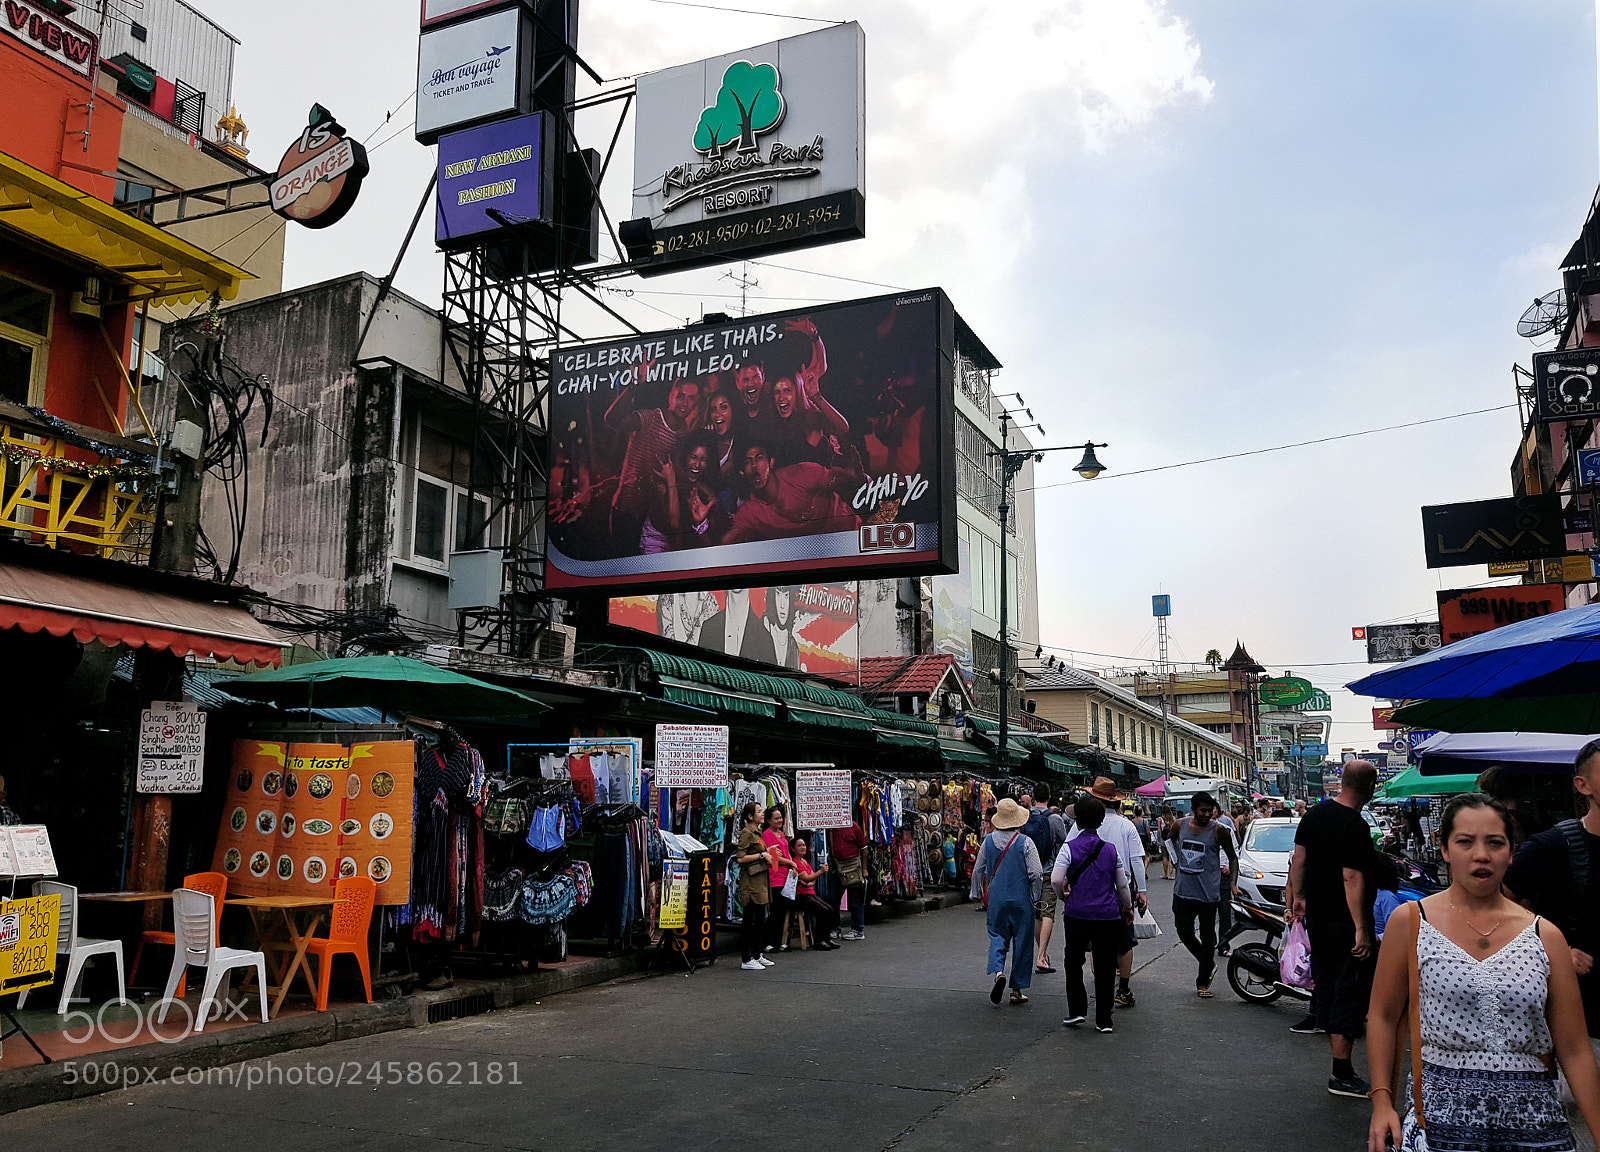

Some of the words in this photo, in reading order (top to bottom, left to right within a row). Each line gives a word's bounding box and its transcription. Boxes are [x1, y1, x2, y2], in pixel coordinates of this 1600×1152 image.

[5, 0, 90, 64] VIEW
[431, 68, 455, 86] Bon
[459, 58, 501, 80] voyage
[433, 87, 455, 99] TICKET
[455, 83, 470, 93] AND
[471, 77, 495, 89] TRAVEL
[299, 121, 332, 153] IS
[275, 147, 349, 200] ORANGE
[445, 159, 477, 179] NEW
[477, 145, 532, 172] ARMANI
[662, 151, 762, 197] Khaosan
[768, 134, 824, 165] Park
[458, 179, 516, 205] FASHION
[703, 185, 773, 213] RESORT
[673, 333, 715, 356] LIKE
[720, 323, 785, 347] THAIS.
[557, 366, 639, 396] CHAI-YO!
[646, 360, 690, 384] WITH
[862, 524, 913, 550] LEO
[142, 711, 169, 725] Chang
[175, 711, 206, 724] 80/100
[165, 702, 184, 711] Beer
[141, 734, 166, 746] Singha
[142, 724, 161, 733] Leo
[293, 756, 304, 768] to
[309, 756, 350, 769] taste
[140, 783, 165, 792] Vodka
[701, 857, 711, 951] TATTOO
